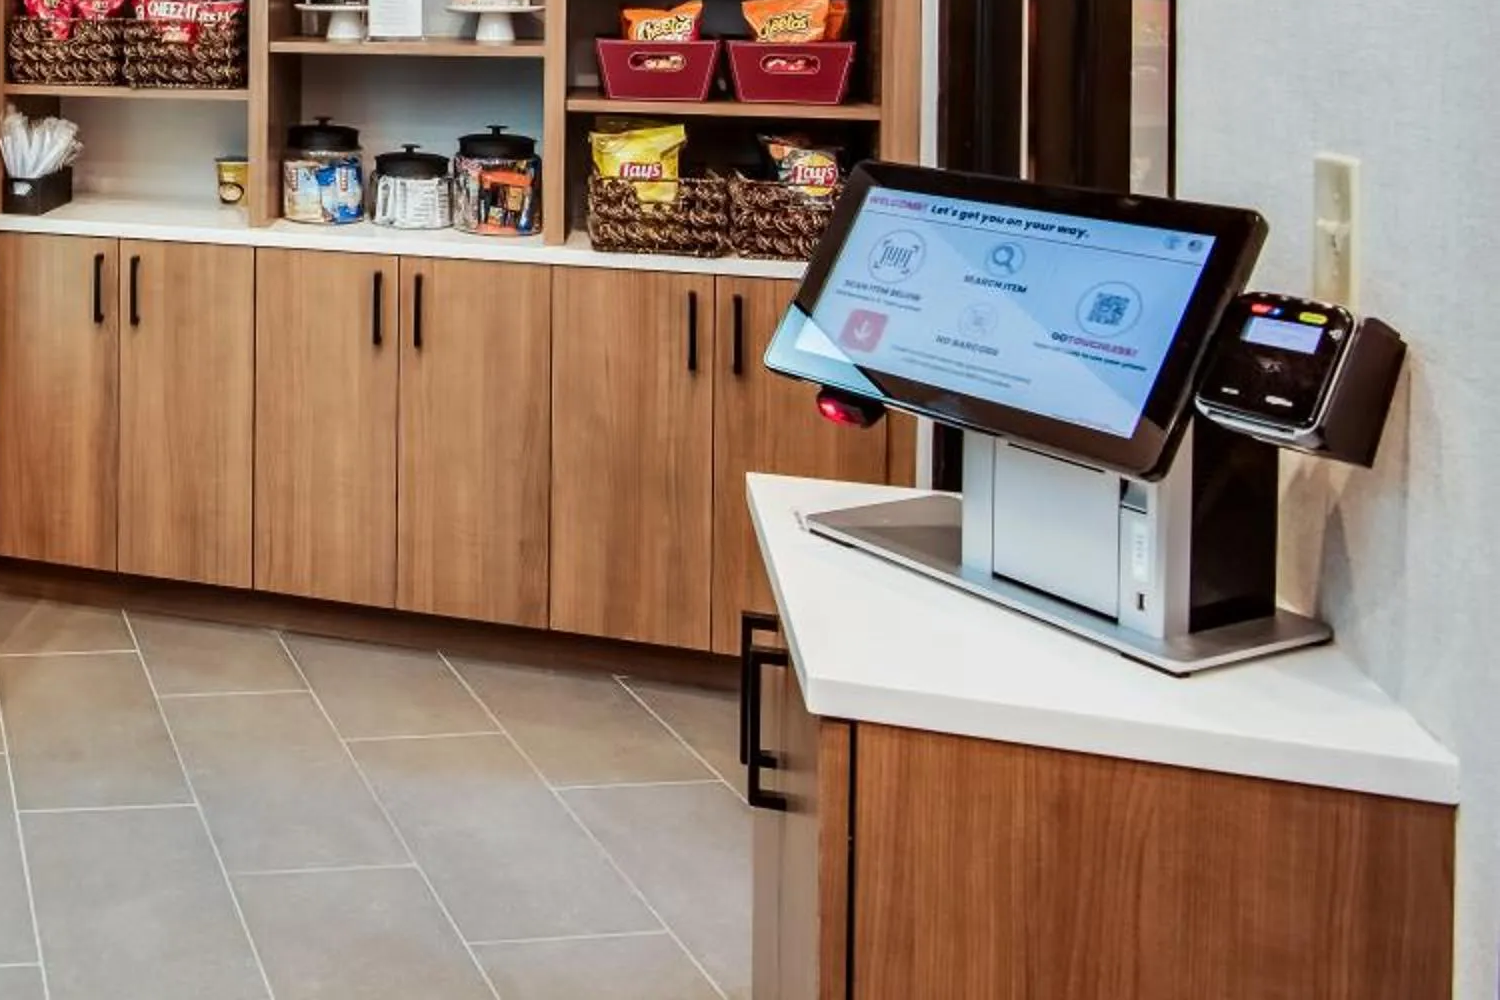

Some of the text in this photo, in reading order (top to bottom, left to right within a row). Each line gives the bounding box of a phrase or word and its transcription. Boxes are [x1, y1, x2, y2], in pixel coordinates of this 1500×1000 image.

[930, 203, 959, 217] Let's
[958, 209, 980, 221] get
[980, 213, 1005, 225] you
[1006, 217, 1023, 226] on
[1024, 219, 1057, 231] your
[1057, 224, 1091, 239] way.
[963, 274, 1029, 294] SEARCH ITEM
